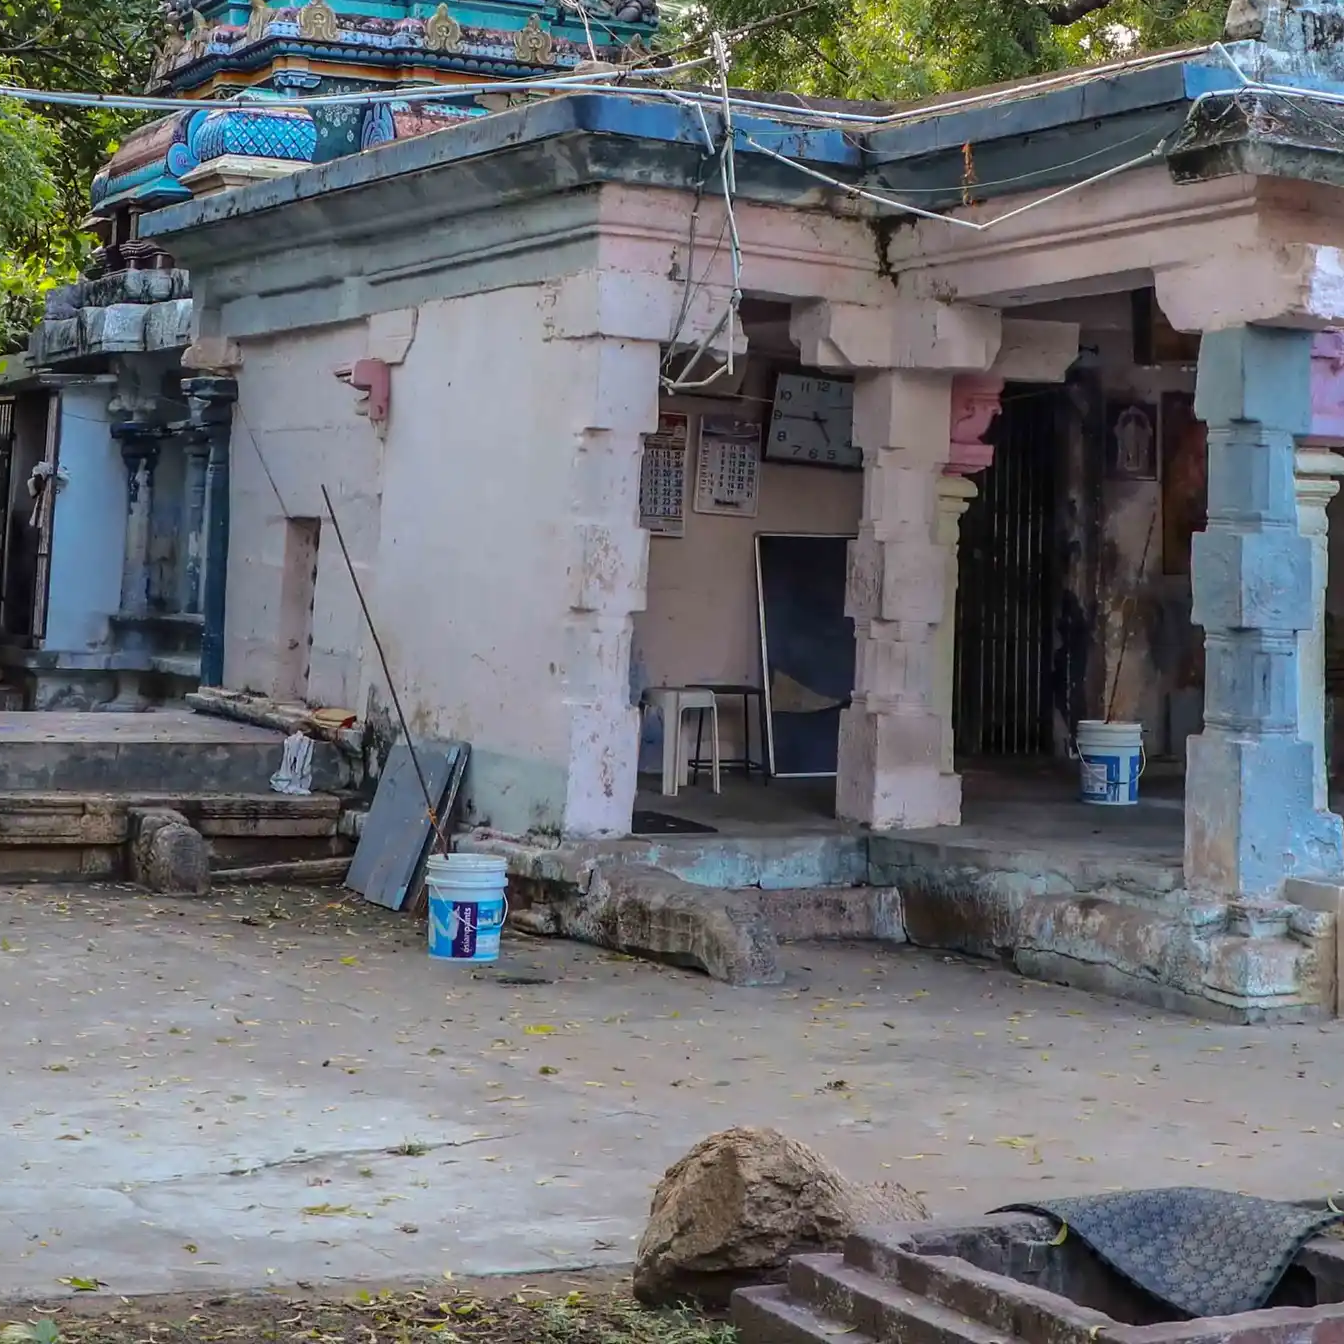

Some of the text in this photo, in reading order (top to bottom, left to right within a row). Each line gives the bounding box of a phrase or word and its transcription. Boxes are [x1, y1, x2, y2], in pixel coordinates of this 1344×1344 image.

[801, 382, 810, 393] 11
[817, 381, 830, 392] 12
[780, 390, 792, 401] 10
[777, 431, 787, 442] 8
[791, 445, 801, 455] 7
[808, 448, 818, 459] 6
[827, 449, 836, 460] 5
